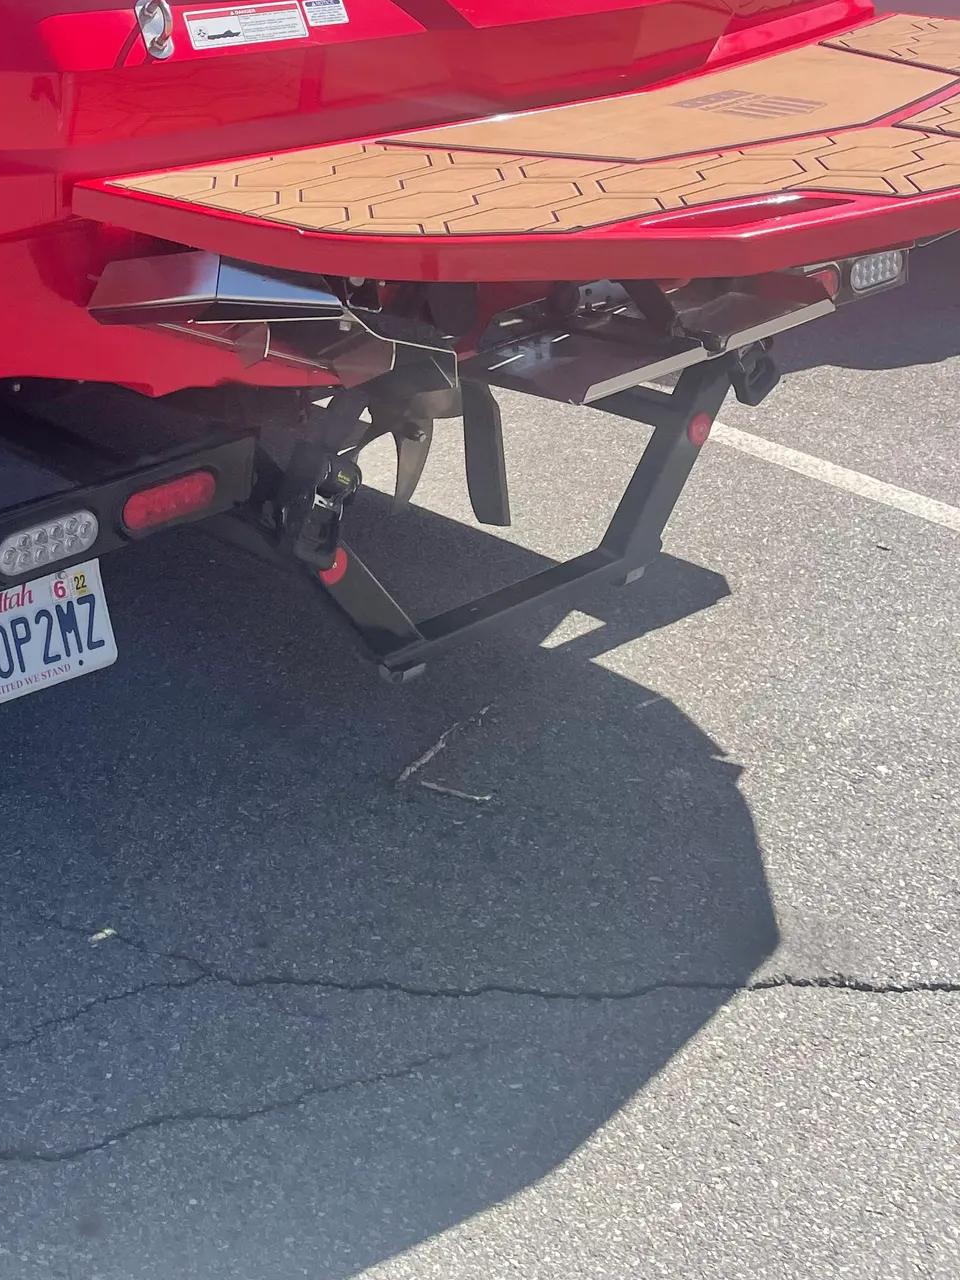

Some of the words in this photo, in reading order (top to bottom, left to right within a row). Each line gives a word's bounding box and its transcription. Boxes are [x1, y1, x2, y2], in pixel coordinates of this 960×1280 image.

[54, 581, 67, 598] 6
[74, 575, 87, 590] 22
[24, 674, 40, 685] WE
[41, 663, 71, 680] STAND
